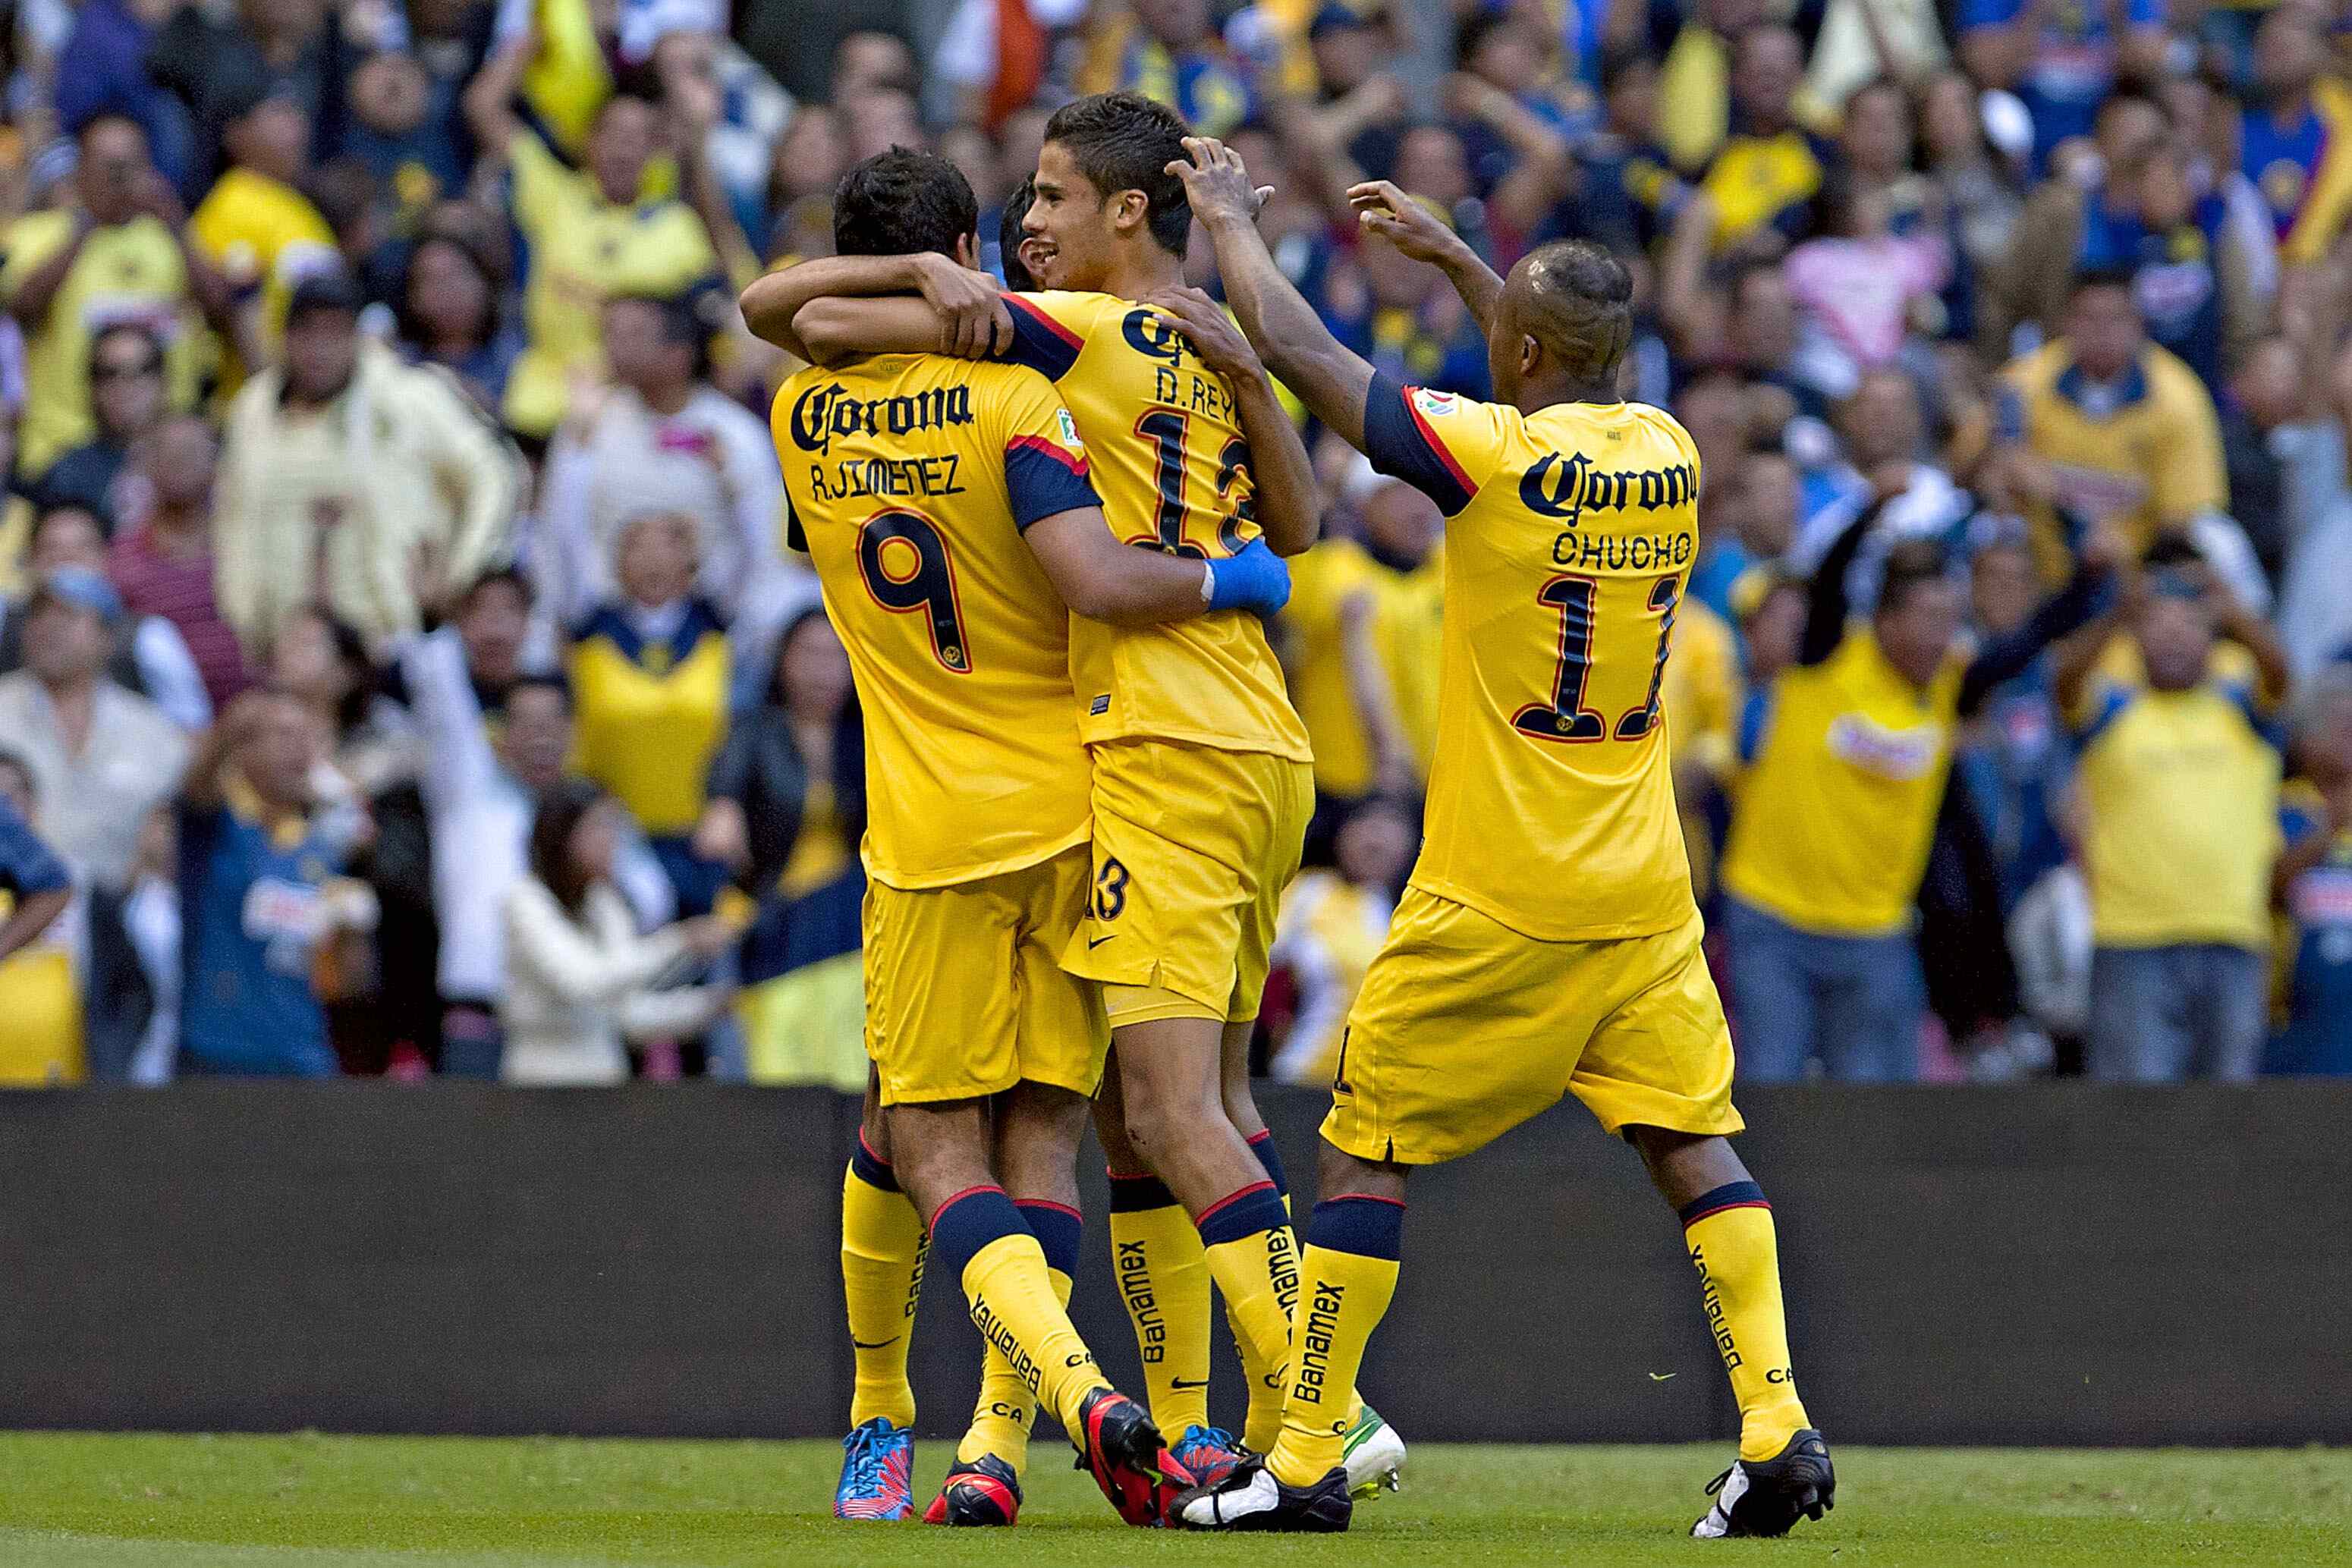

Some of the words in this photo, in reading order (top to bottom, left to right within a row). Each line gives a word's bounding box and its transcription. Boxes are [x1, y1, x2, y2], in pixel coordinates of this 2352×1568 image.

[791, 382, 974, 457] Corona
[855, 506, 973, 674] 9
[1552, 532, 1690, 570] CHUCHO
[1509, 573, 1681, 744] 11
[970, 1293, 1042, 1396] Banamex
[1119, 1240, 1166, 1363] Banamex
[1294, 1280, 1345, 1404] Banamex
[992, 1403, 1022, 1423] CA
